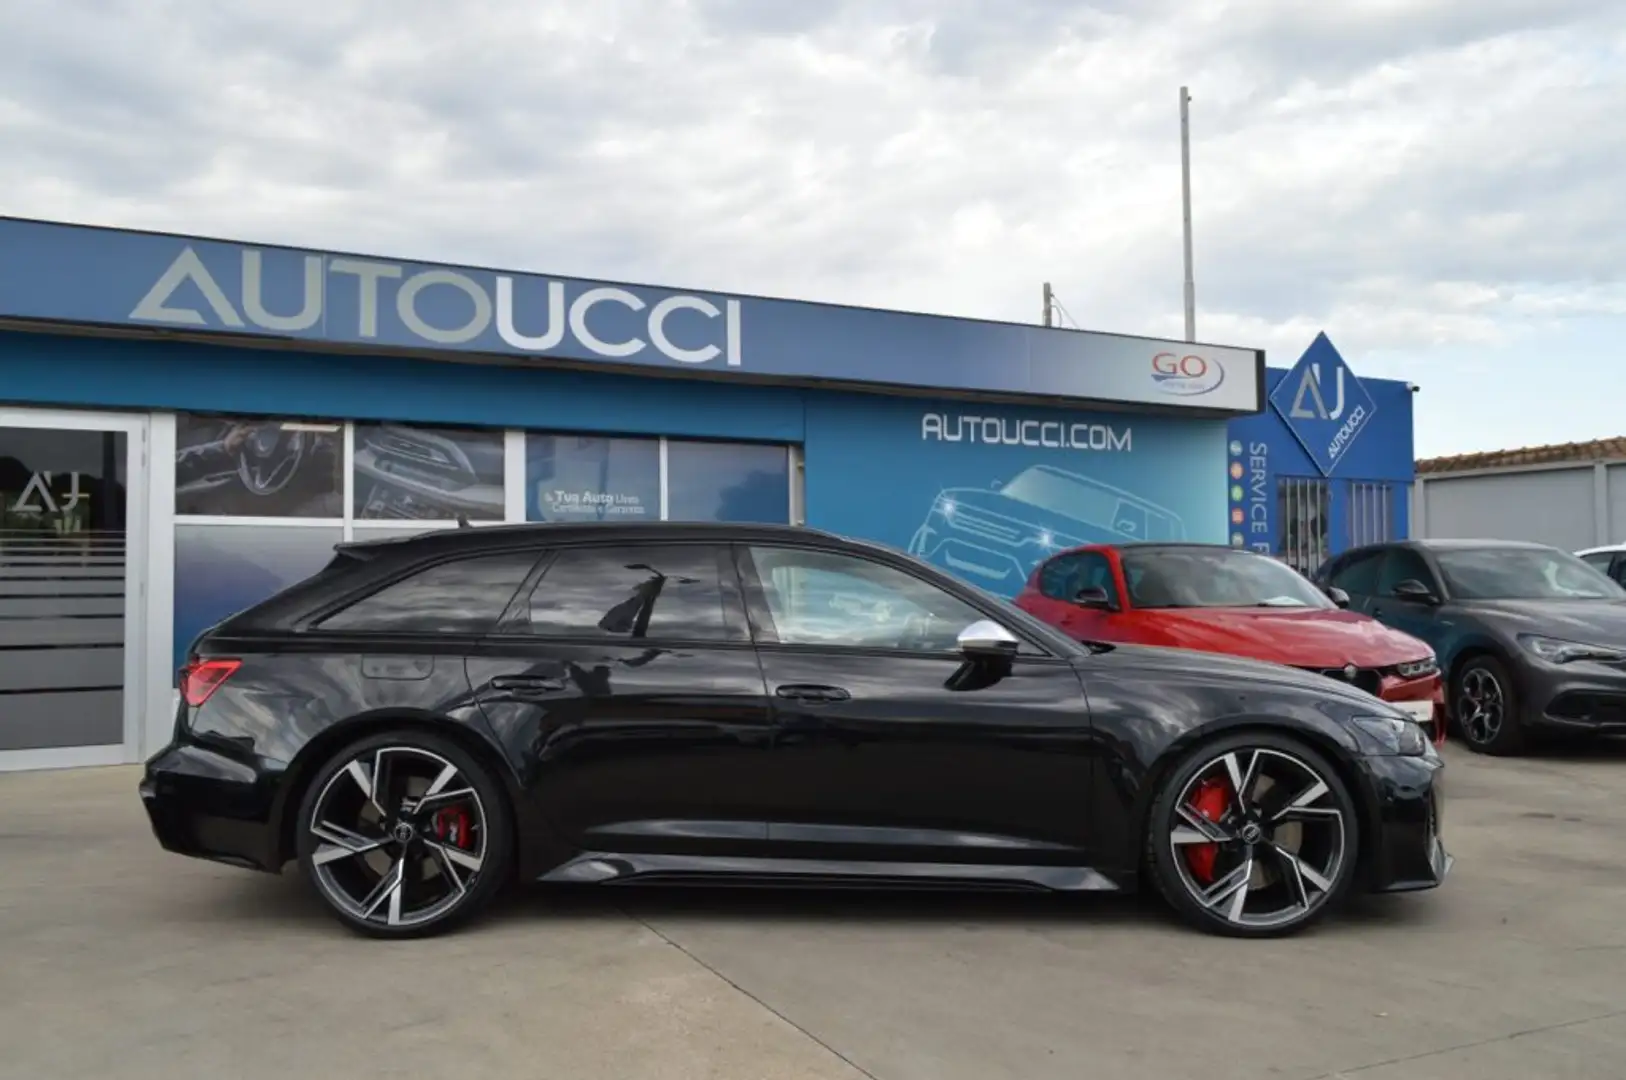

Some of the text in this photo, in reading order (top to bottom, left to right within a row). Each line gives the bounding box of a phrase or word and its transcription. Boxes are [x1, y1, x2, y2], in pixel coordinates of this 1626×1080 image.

[129, 245, 743, 367] AUTOUCCI
[1152, 352, 1206, 378] GO
[921, 412, 1132, 452] AUTOUCCI.COM
[1328, 405, 1365, 459] AUTOUCCI
[1249, 441, 1268, 533] SERVICE
